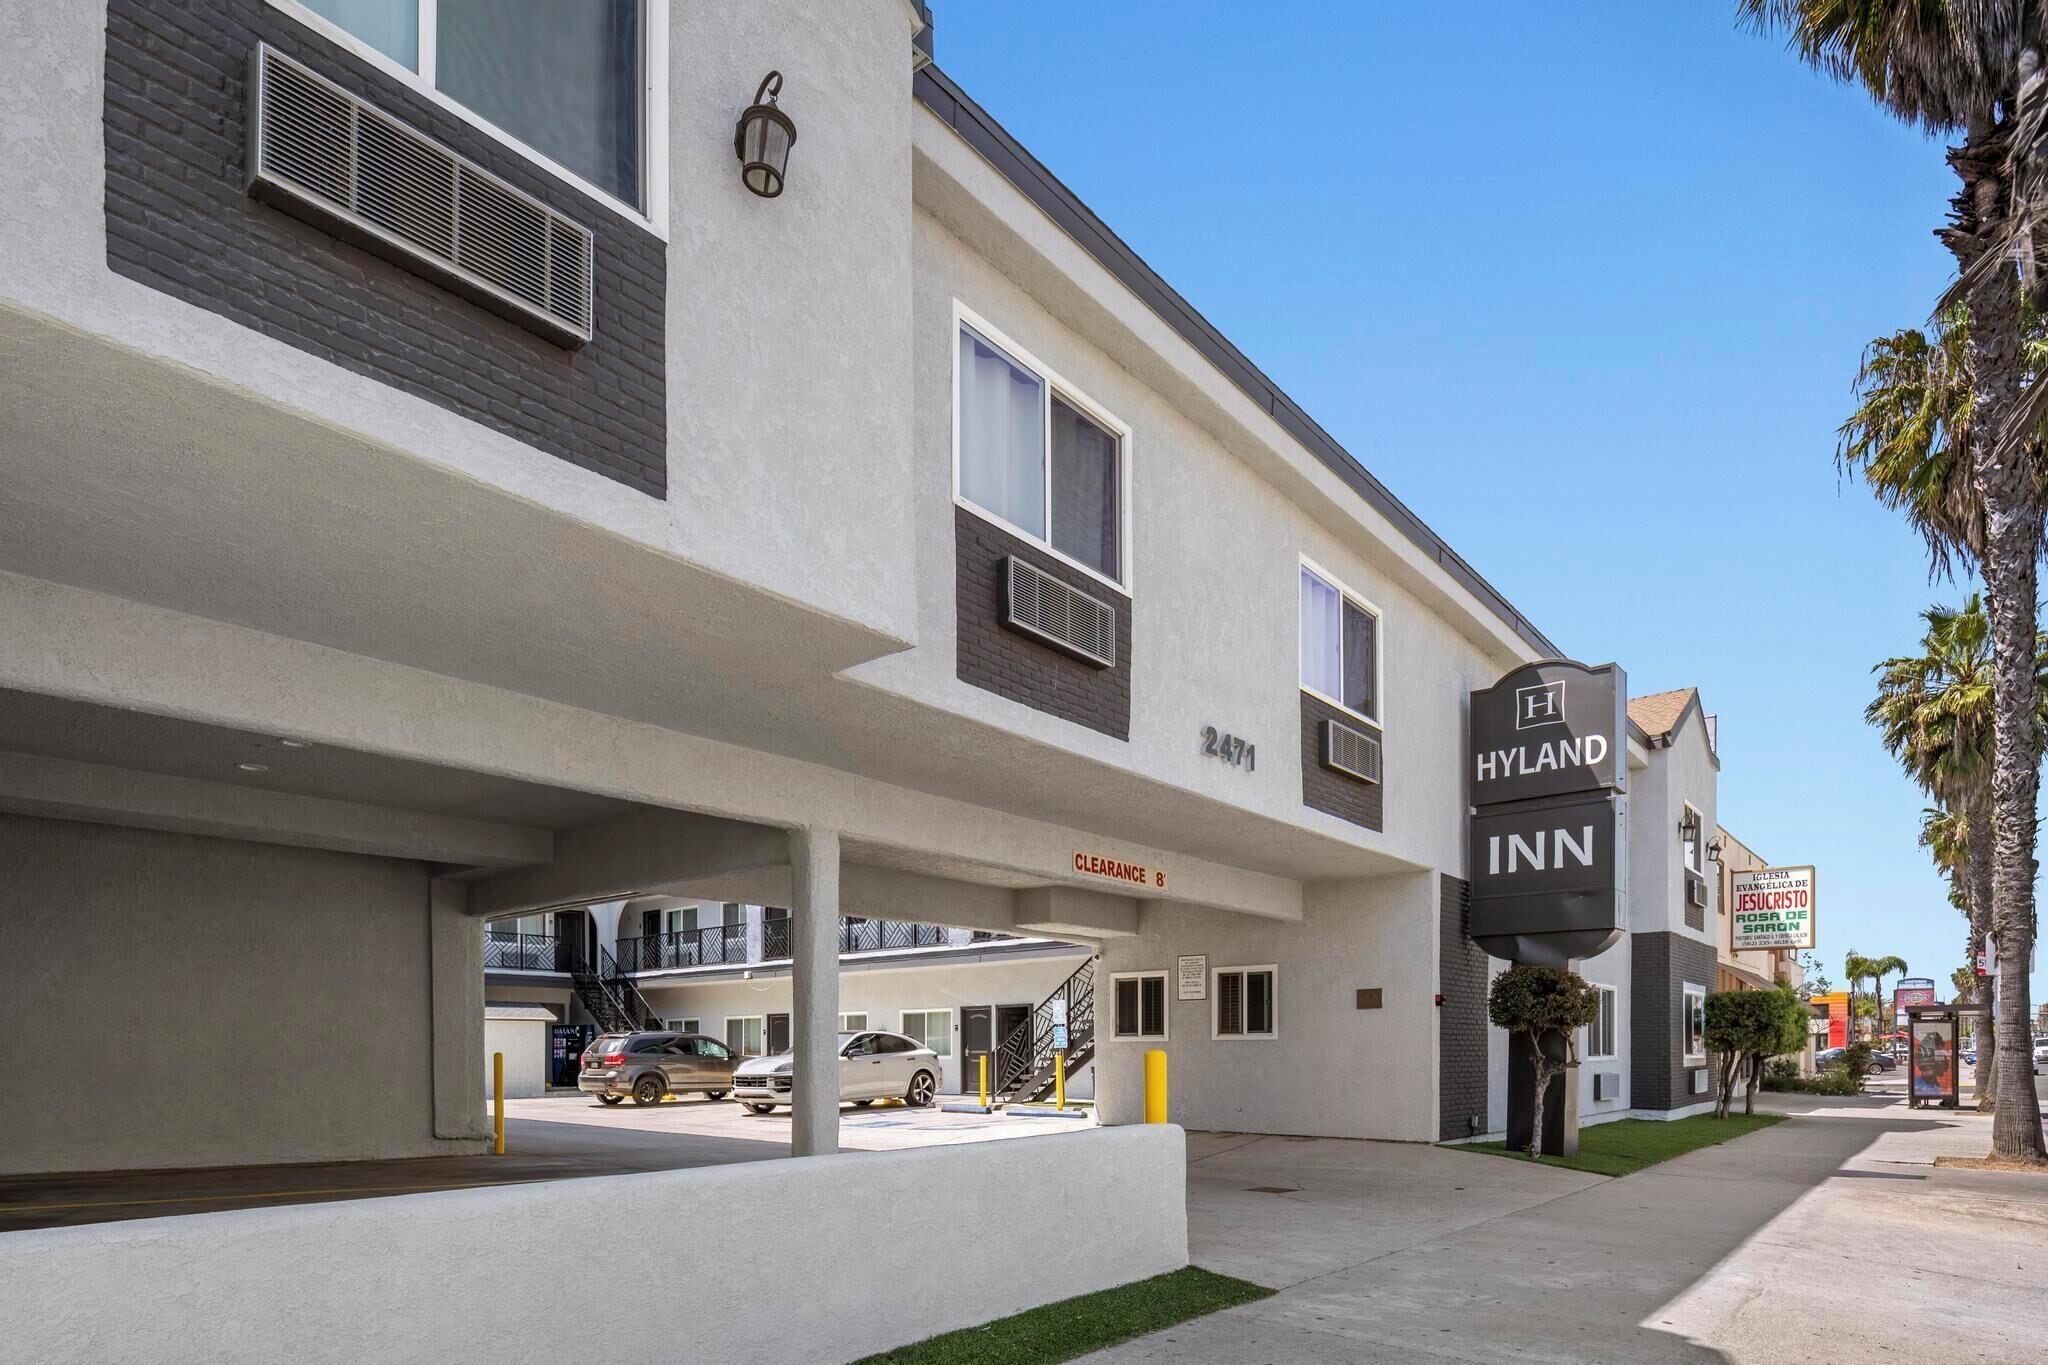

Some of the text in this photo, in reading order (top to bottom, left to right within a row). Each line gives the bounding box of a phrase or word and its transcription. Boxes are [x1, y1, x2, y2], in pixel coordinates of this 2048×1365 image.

[1524, 691, 1557, 720] H
[1204, 725, 1256, 772] 2471
[1477, 734, 1608, 782] HYLAND
[1489, 825, 1594, 875] INN
[1075, 853, 1146, 884] CLEARANCE
[1753, 872, 1789, 881] IGLESIA
[1736, 890, 1808, 912] JESUCRISTO
[1736, 911, 1807, 923] ROSA DE
